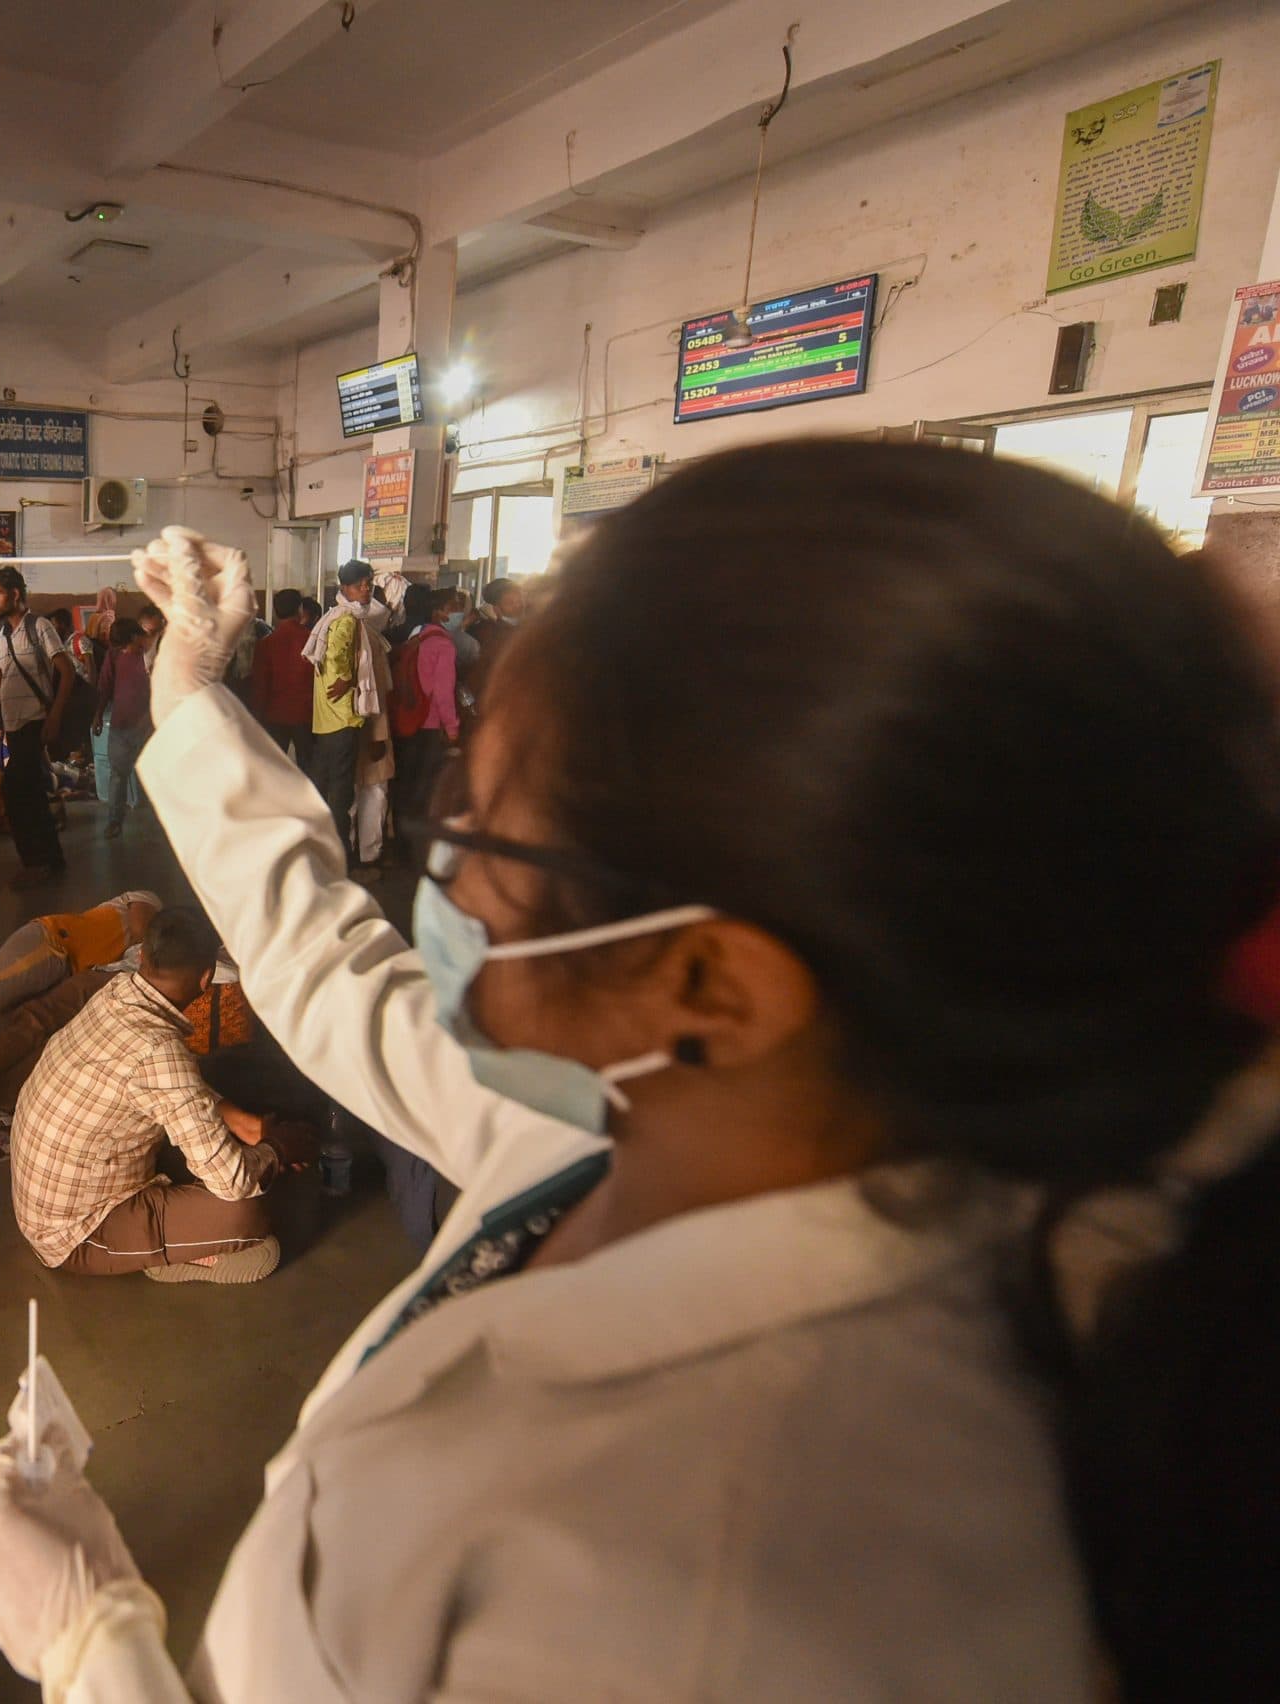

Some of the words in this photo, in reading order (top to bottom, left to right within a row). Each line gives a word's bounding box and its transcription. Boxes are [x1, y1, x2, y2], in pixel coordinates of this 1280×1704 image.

[1070, 264, 1095, 281] Go
[687, 334, 723, 349] 05489
[838, 332, 847, 343] 5
[685, 360, 720, 375] 22453
[835, 361, 844, 371] 1
[1229, 372, 1280, 390] LUCKNOW
[683, 386, 718, 400] 15204
[1247, 390, 1266, 402] PCI
[1260, 429, 1279, 437] MBA
[21, 452, 39, 470] TICKET
[63, 455, 84, 472] MACHINE
